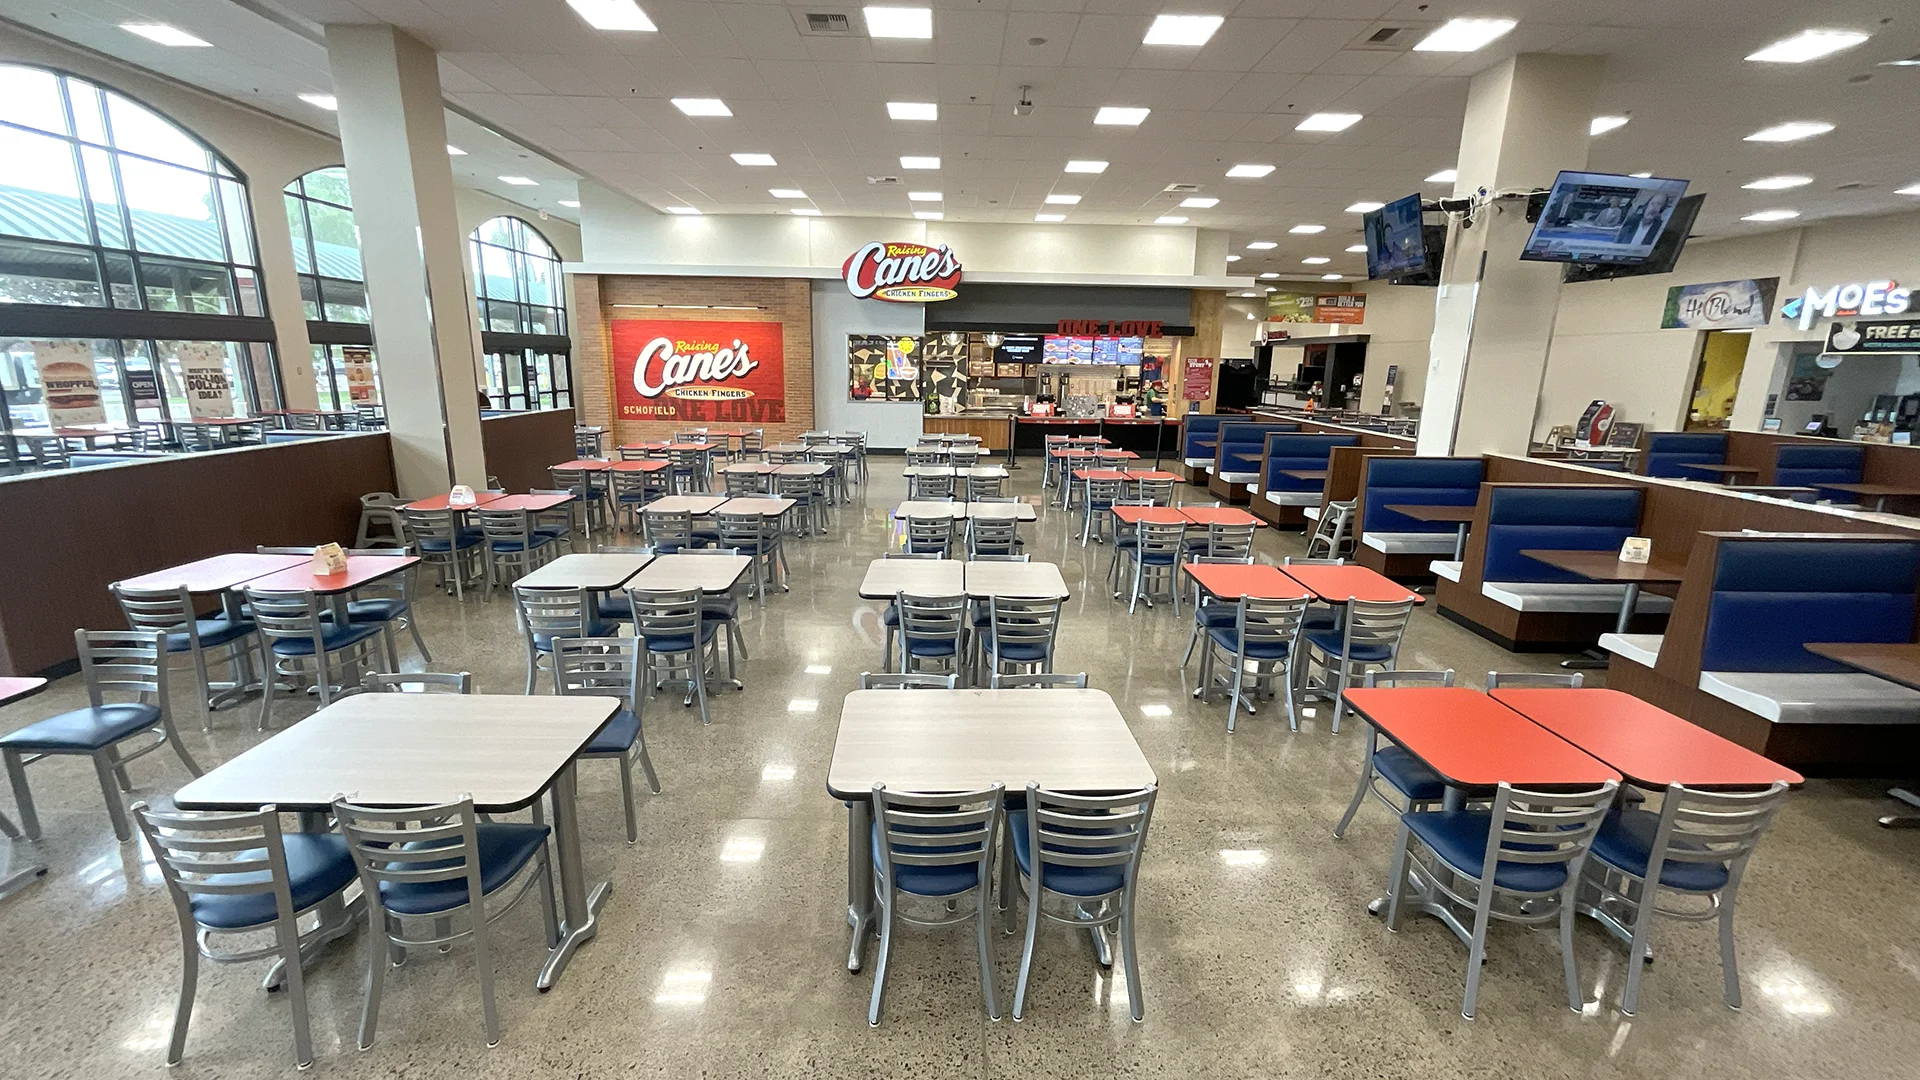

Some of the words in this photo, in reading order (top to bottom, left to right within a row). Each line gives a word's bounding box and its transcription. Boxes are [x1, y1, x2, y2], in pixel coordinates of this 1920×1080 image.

[887, 245, 927, 258] Raising
[846, 241, 962, 299] Cane's
[885, 289, 917, 297] CHICKEN
[1708, 294, 1754, 315] Blend
[1057, 319, 1101, 336] ONE
[1108, 320, 1164, 338] LOVE
[1865, 325, 1911, 339] FREE
[675, 340, 720, 354] Raising
[633, 336, 759, 398] Cane's
[46, 380, 97, 389] WHOPPER
[131, 381, 154, 389] OPEN
[187, 374, 227, 384] MILLION
[188, 380, 229, 390] DOLLAR
[198, 391, 223, 399] IDEA?
[675, 388, 709, 397] CHICKEN
[711, 389, 746, 398] FINGERS
[623, 405, 676, 416] SCHOFIELD
[714, 399, 785, 422] LOVE
